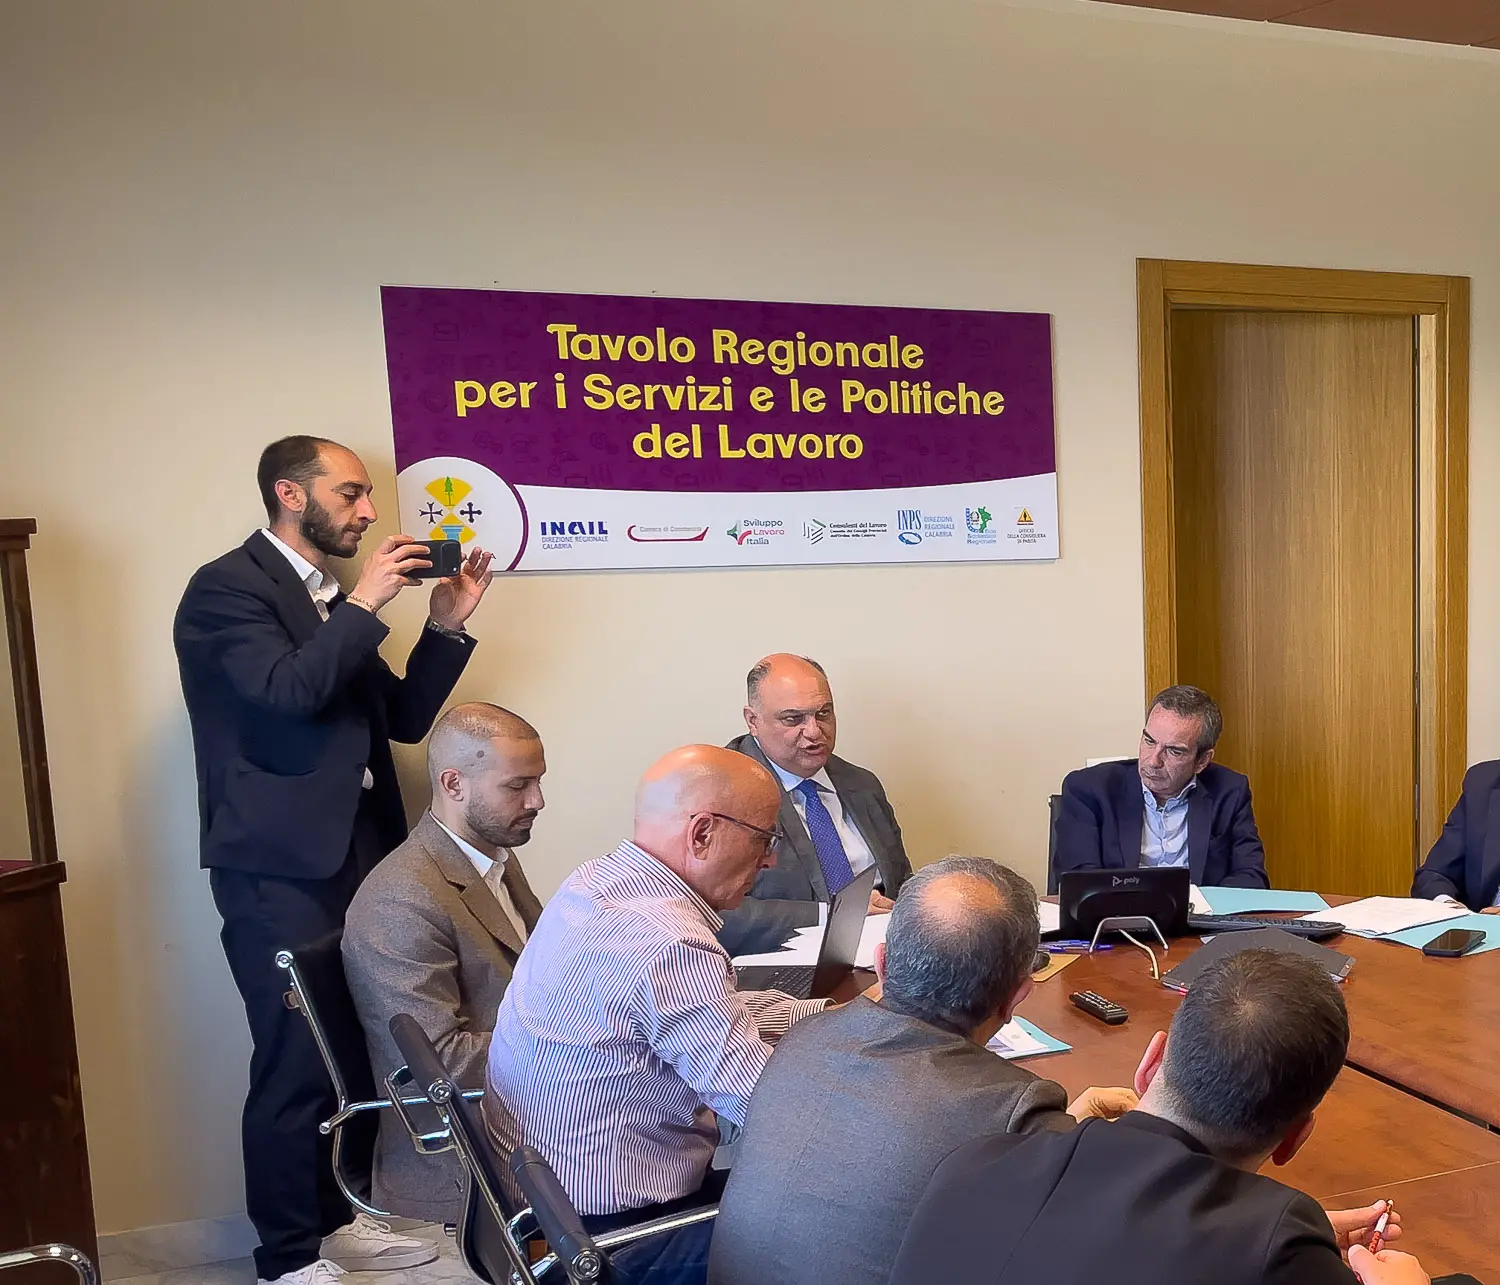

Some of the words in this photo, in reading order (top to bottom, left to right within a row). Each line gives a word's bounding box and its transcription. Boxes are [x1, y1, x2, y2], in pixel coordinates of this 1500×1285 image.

[547, 323, 696, 363] Tavolo
[713, 329, 924, 375] Regionale
[455, 380, 537, 417] per
[555, 373, 567, 409] i
[584, 373, 733, 411] Servizi
[749, 387, 774, 412] e
[790, 379, 825, 413] le
[842, 379, 1004, 415] Politiche
[633, 423, 702, 459] del
[719, 424, 864, 459] Lavoro
[540, 521, 608, 535] INAIL
[743, 518, 784, 528] Sviluppo
[896, 509, 922, 530] INPS
[746, 537, 770, 545] Italia
[1123, 876, 1140, 886] poly
